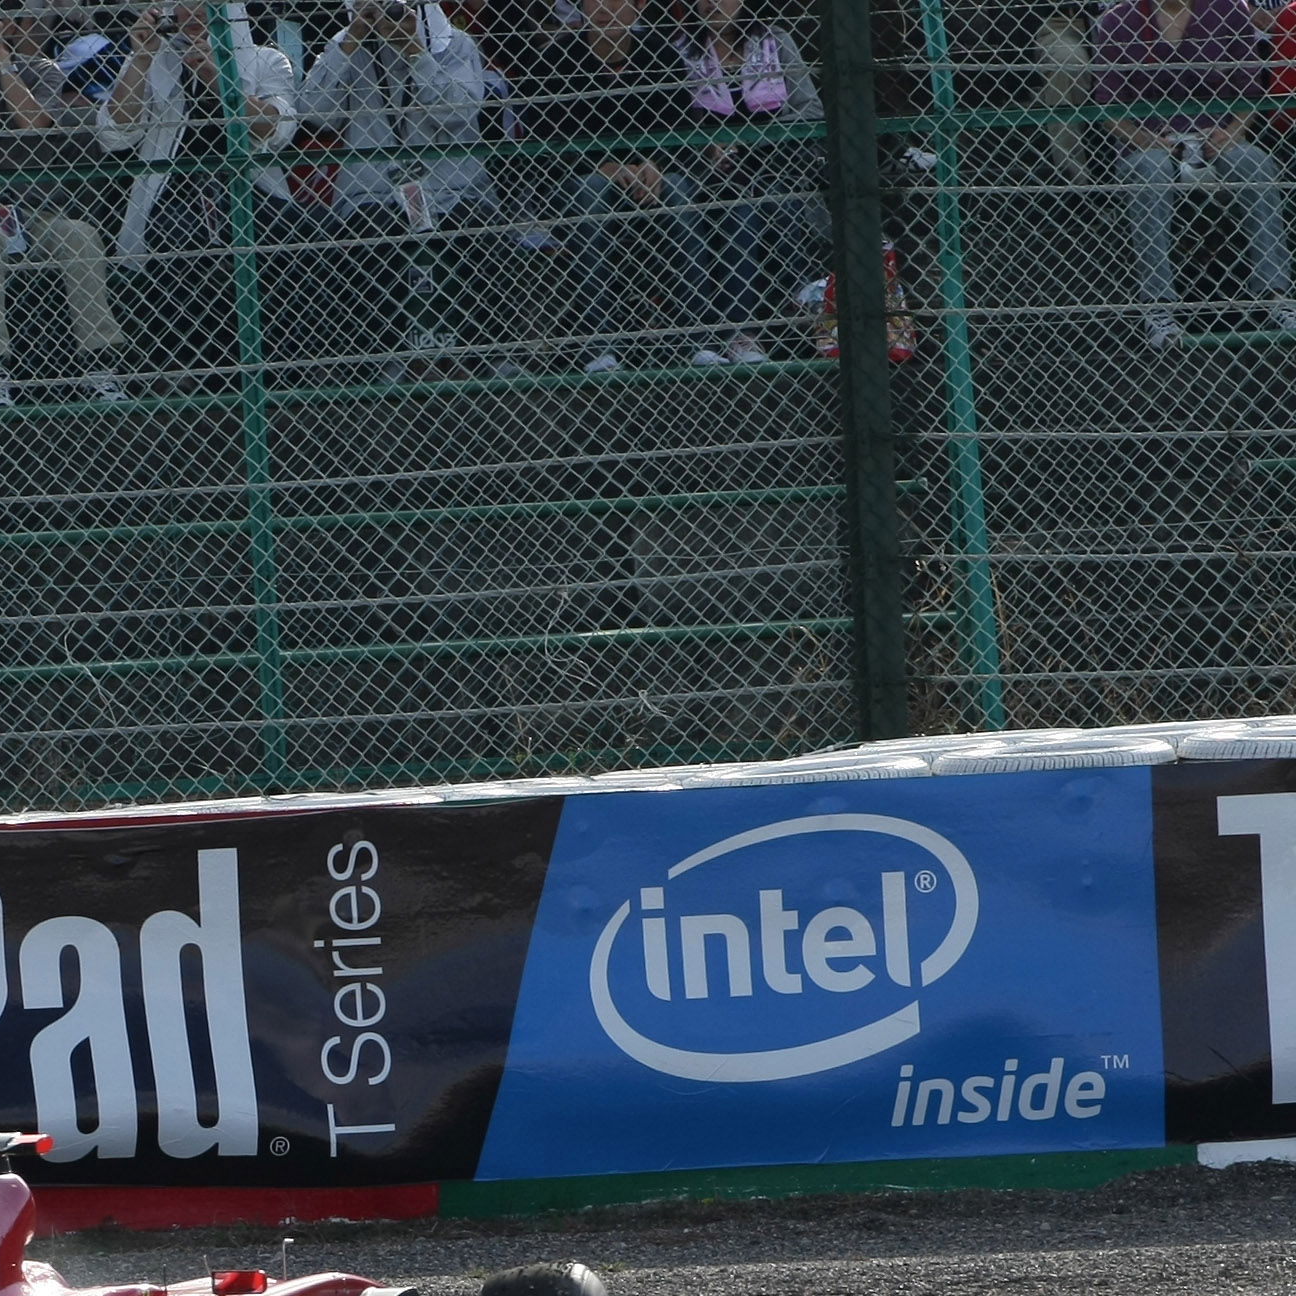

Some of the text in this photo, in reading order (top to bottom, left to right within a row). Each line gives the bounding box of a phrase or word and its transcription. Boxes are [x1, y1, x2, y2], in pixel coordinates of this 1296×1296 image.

[314, 840, 396, 1158] T Series
[641, 871, 911, 1002] intel
[891, 1057, 1106, 1128] inside
